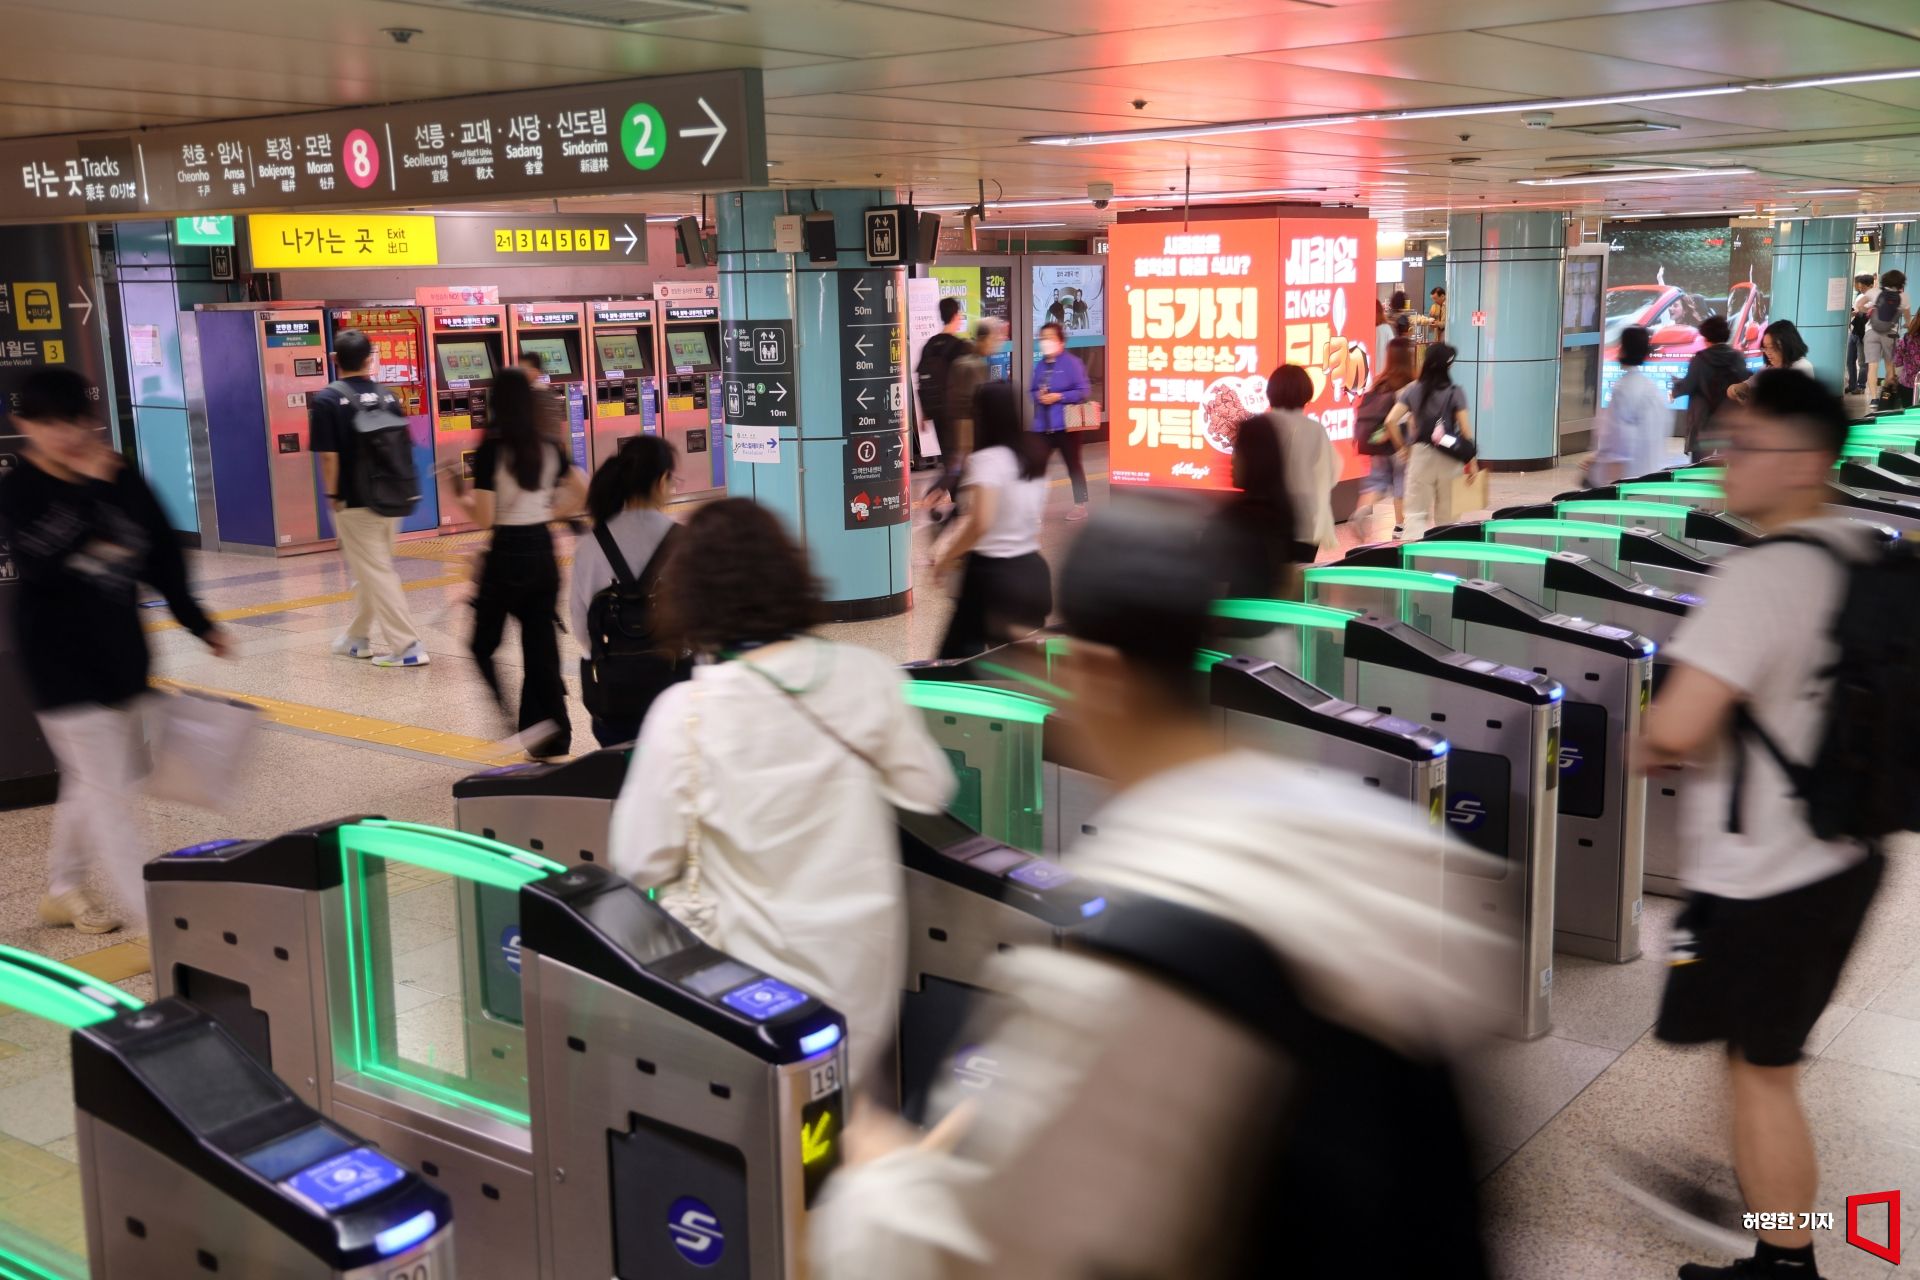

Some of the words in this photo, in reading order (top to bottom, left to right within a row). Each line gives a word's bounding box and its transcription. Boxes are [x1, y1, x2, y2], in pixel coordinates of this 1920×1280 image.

[414, 122, 445, 150] 선릉
[460, 118, 492, 145] 교대
[508, 114, 540, 142] 사당
[556, 108, 608, 138] 신도림
[632, 113, 656, 158] 2
[182, 143, 208, 167] 천호
[217, 140, 243, 165] 암사
[266, 136, 293, 161] 복정
[305, 133, 332, 158] 모란
[451, 149, 466, 159] Seoul
[505, 143, 543, 159] Sadang
[562, 139, 608, 157] Sindorim
[80, 155, 120, 177] Tracks
[351, 138, 371, 178] 8
[403, 152, 448, 169] Seolleung
[461, 157, 467, 166] of
[467, 155, 494, 165] Education
[22, 160, 60, 198] 타는
[63, 159, 83, 197] 곳
[177, 169, 210, 183] Cheonho
[223, 167, 245, 180] Amsa
[258, 163, 296, 180] Bokjeong
[306, 161, 334, 175] Moran
[109, 181, 137, 199] のりば
[281, 227, 347, 254] 나가는
[354, 228, 375, 254] 곳
[386, 227, 405, 240] Exit
[496, 234, 512, 248] 2-1
[520, 233, 528, 248] 3
[540, 233, 549, 247] 4
[560, 232, 568, 247] 5
[579, 232, 587, 246] 6
[597, 232, 606, 246] 7
[387, 241, 408, 254] 出口
[1285, 235, 1359, 286] 시리얼
[990, 275, 1005, 287] 20%
[940, 285, 967, 297] GRAND
[986, 286, 1005, 298] SALE
[31, 308, 48, 317] BUS
[854, 306, 872, 316] 50m
[1126, 287, 1258, 339] 15가지
[49, 345, 58, 359] 3
[1127, 345, 1169, 371] 필수
[1172, 345, 1258, 373] 영양소가
[855, 360, 874, 371] 80m
[1127, 377, 1147, 402] 한
[770, 409, 787, 417] 10m
[858, 416, 876, 426] 20m
[1127, 407, 1205, 450] 가득!
[851, 466, 882, 475] 고객안내센터
[1171, 461, 1210, 480] Kellogg's
[813, 1064, 837, 1096] 19
